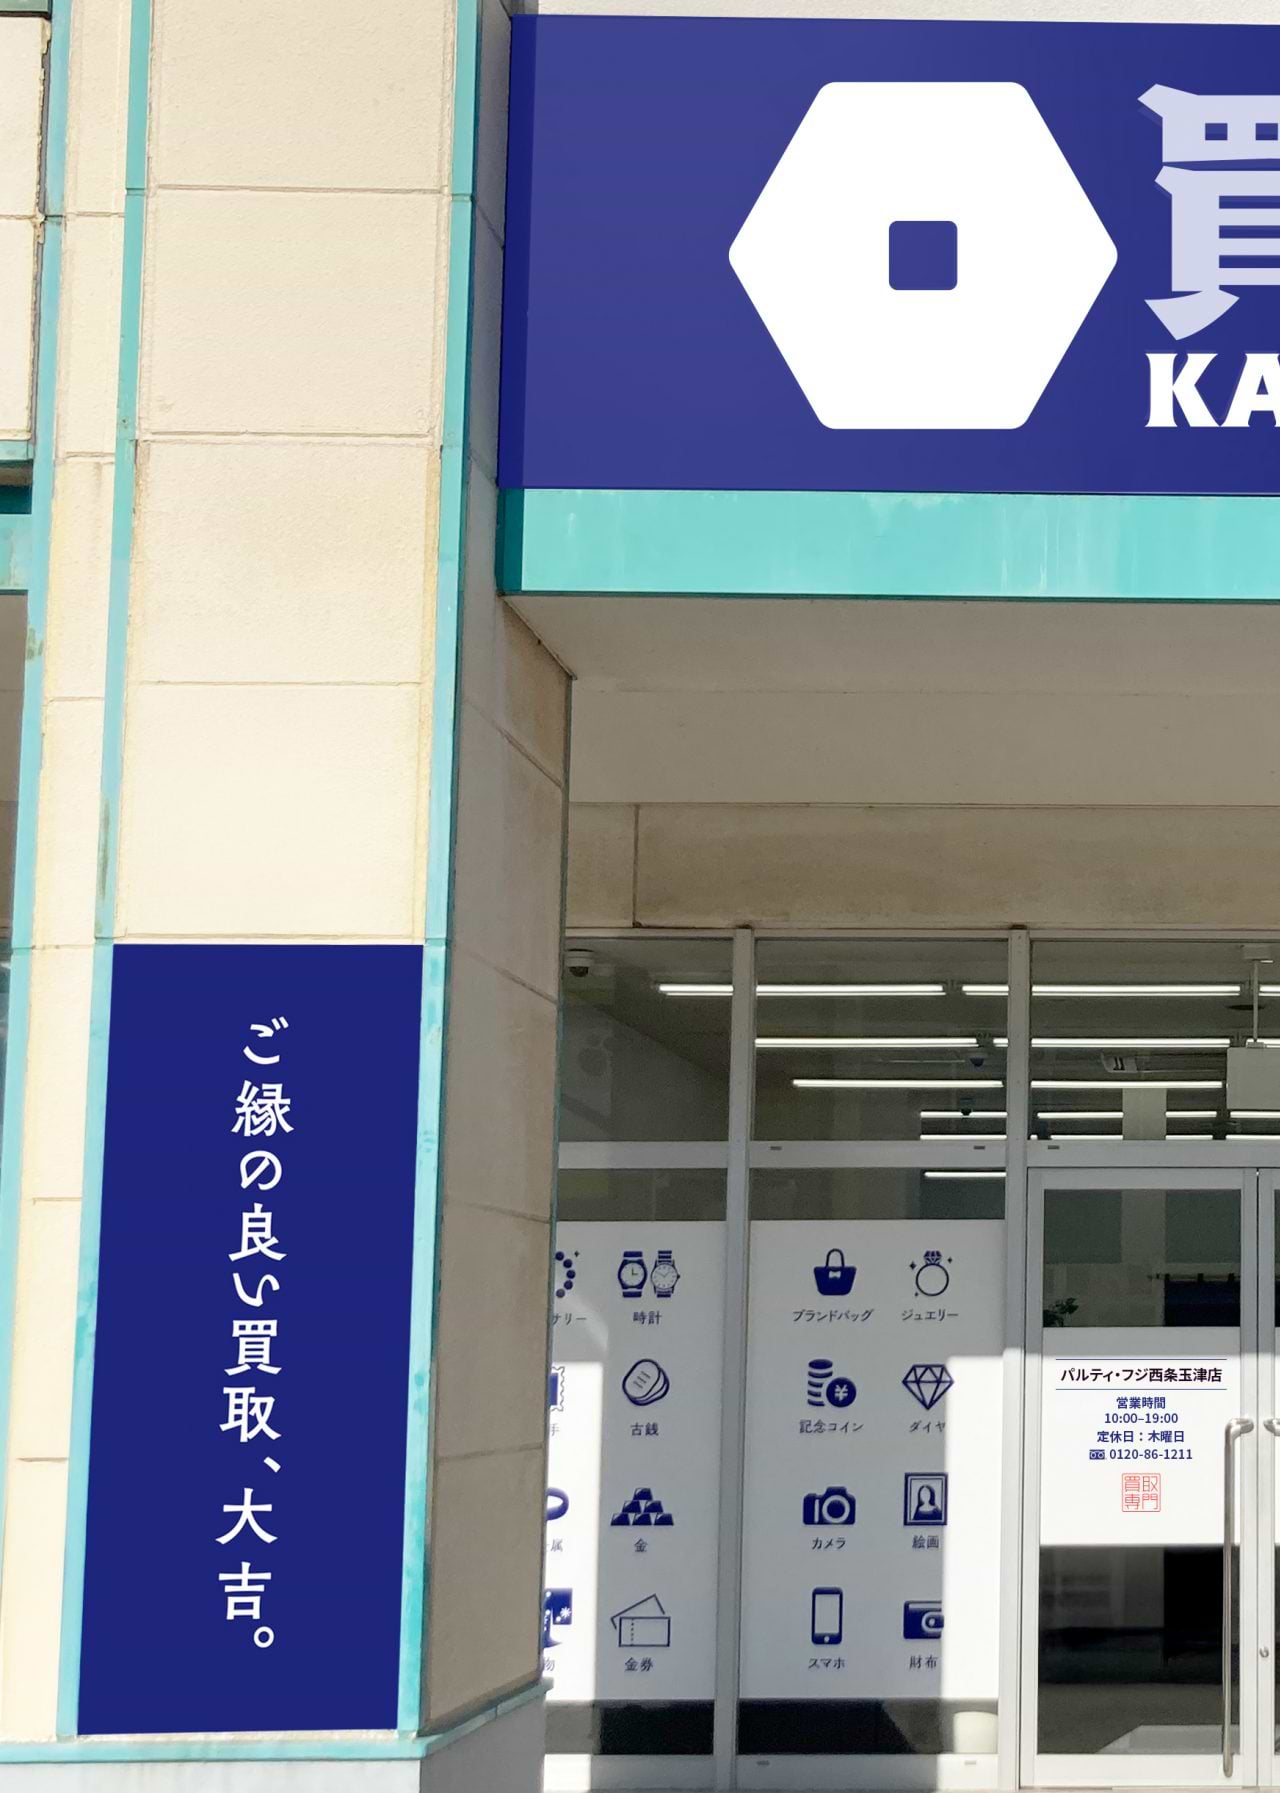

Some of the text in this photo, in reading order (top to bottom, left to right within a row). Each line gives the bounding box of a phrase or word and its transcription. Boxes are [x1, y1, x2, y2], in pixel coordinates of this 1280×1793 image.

[632, 1310, 662, 1325] 時計
[792, 1308, 875, 1323] ブランドバッグ
[901, 1308, 959, 1322] ジュエリー
[215, 1016, 294, 1648] ご縁の良い買取、大吉。
[1060, 1367, 1223, 1383] パルティ・フジ西条玉津店
[1116, 1396, 1166, 1410] 営業時間
[630, 1422, 660, 1437] 古銭
[799, 1419, 864, 1434] 記念コイン
[909, 1420, 946, 1434] ダイヤ
[1109, 1448, 1193, 1460] 0120-86-1211
[1124, 1475, 1158, 1492] 買取
[1124, 1493, 1158, 1510] 専門
[634, 1538, 648, 1553] 金
[811, 1537, 846, 1550] カメラ
[911, 1535, 940, 1550] 絵画
[624, 1656, 654, 1672] 金券
[808, 1657, 845, 1670] スマホ
[909, 1654, 938, 1670] 財布
